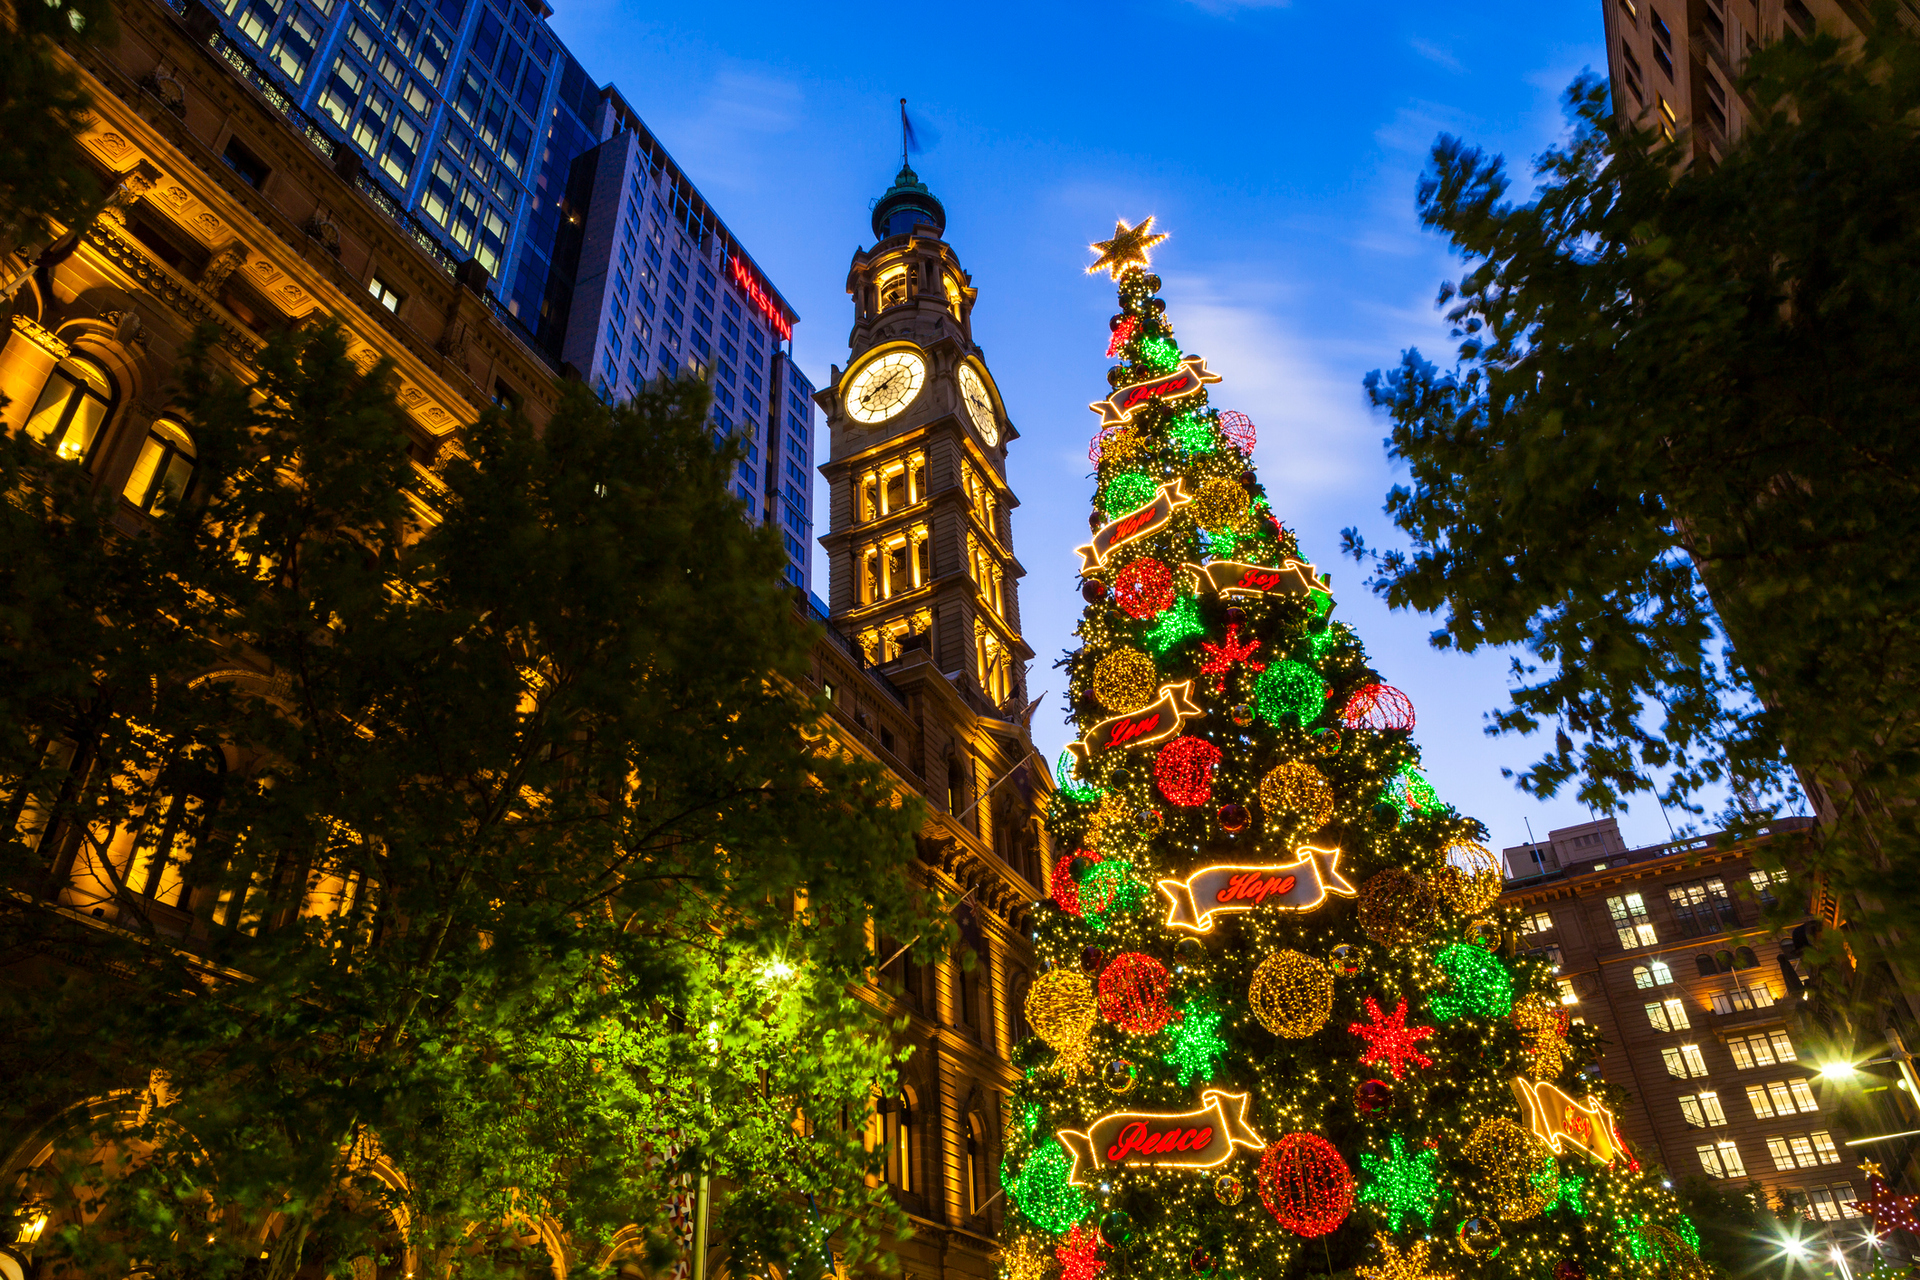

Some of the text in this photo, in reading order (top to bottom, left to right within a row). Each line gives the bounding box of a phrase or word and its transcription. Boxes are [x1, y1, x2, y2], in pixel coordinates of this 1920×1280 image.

[733, 256, 791, 340] WESTIN
[1123, 377, 1188, 408] Peace
[1109, 507, 1156, 544] Hope
[1238, 569, 1280, 591] Joy
[1104, 713, 1160, 750] Love
[1217, 871, 1296, 907] Hope
[1107, 1120, 1213, 1161] Peace
[1563, 1104, 1592, 1144] Joy
